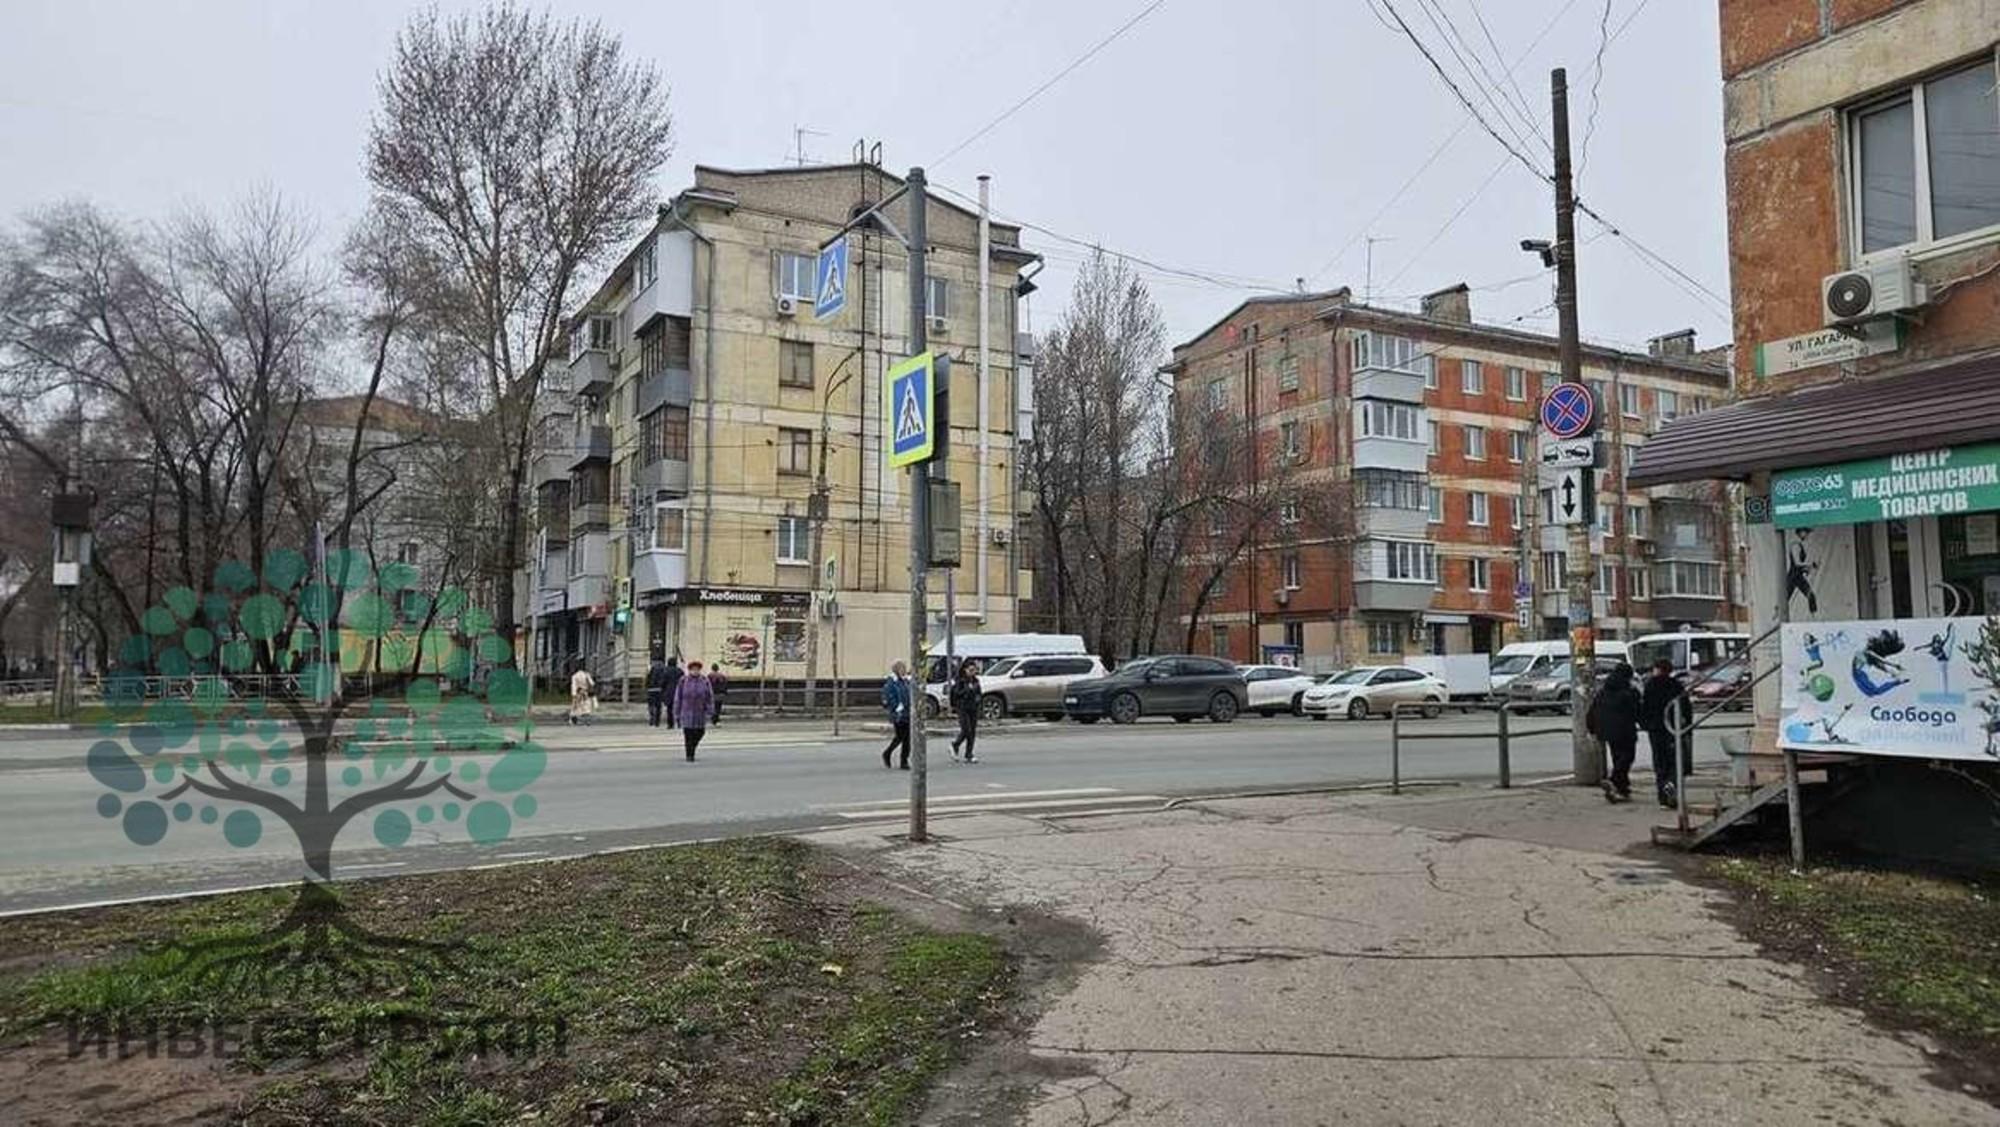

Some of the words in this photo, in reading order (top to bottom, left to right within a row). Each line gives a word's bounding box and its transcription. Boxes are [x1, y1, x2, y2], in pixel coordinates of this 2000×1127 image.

[1890, 448, 1952, 472] ЦЕНТР
[1851, 463, 1999, 499] МЕДИЦИНСКИХ
[1880, 490, 1969, 519] ТОВАРОВ
[699, 589, 763, 602] Хлебница
[1870, 705, 1957, 727] Свобода
